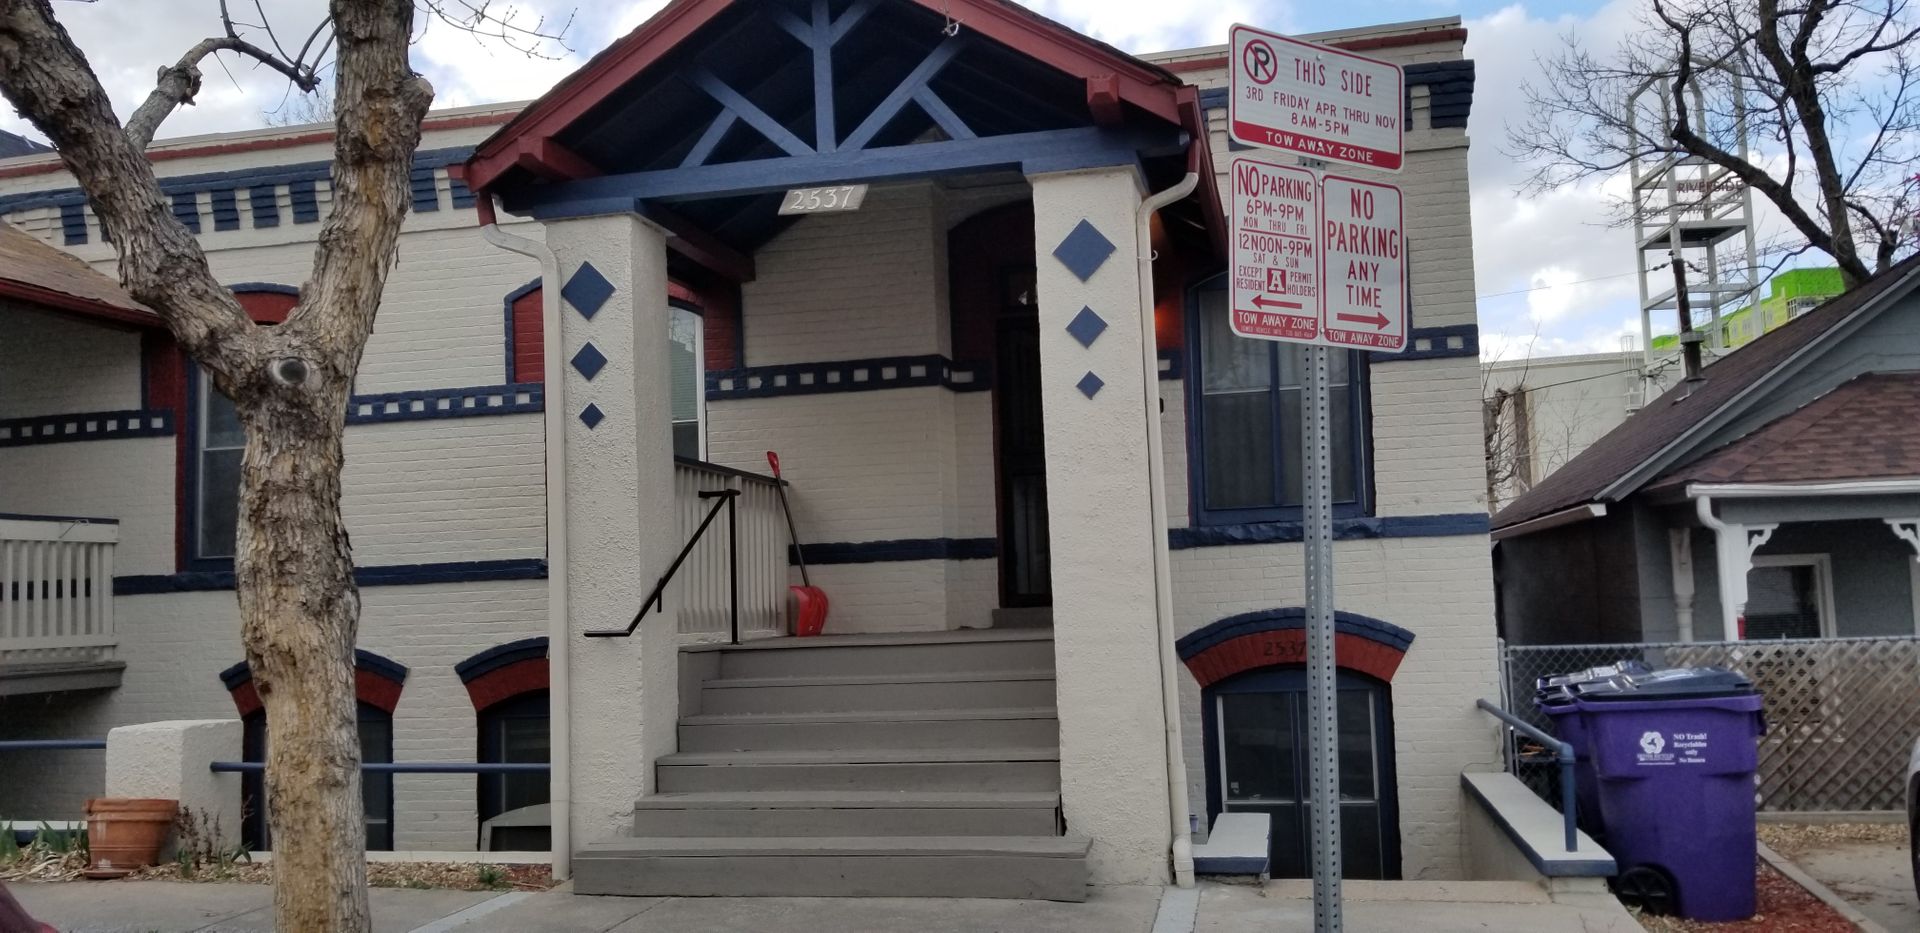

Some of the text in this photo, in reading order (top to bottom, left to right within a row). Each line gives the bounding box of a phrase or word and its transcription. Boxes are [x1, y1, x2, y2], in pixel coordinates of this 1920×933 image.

[1295, 58, 1326, 86] THIS
[1341, 70, 1372, 97] SIDE
[1246, 86, 1396, 130] 3RD FRIDAY APR THRU NOV
[1266, 131, 1373, 163] TOW AWAY ZONE
[1238, 163, 1311, 202] NO PARKING
[790, 185, 856, 210] 2537
[1350, 188, 1374, 220] NO
[1246, 199, 1304, 222] 6PM-9PM
[1243, 216, 1307, 235] MON THRU FRI
[1327, 220, 1398, 260] PARKING
[1253, 252, 1299, 268] SAT & SUN
[1347, 259, 1380, 283] ANY
[1239, 265, 1262, 278] EXCEPT
[1269, 269, 1285, 291] A
[1290, 271, 1312, 284] PERMIT
[1236, 278, 1266, 291] RESIDENT
[1287, 283, 1316, 297] HOLDERS
[1346, 284, 1382, 308] TIME
[1238, 312, 1315, 330] TOW AWAY ZONE
[1328, 330, 1346, 342] TOW
[1351, 332, 1374, 345] AWAY
[1378, 335, 1400, 348] ZONE
[1263, 640, 1306, 656] 2537
